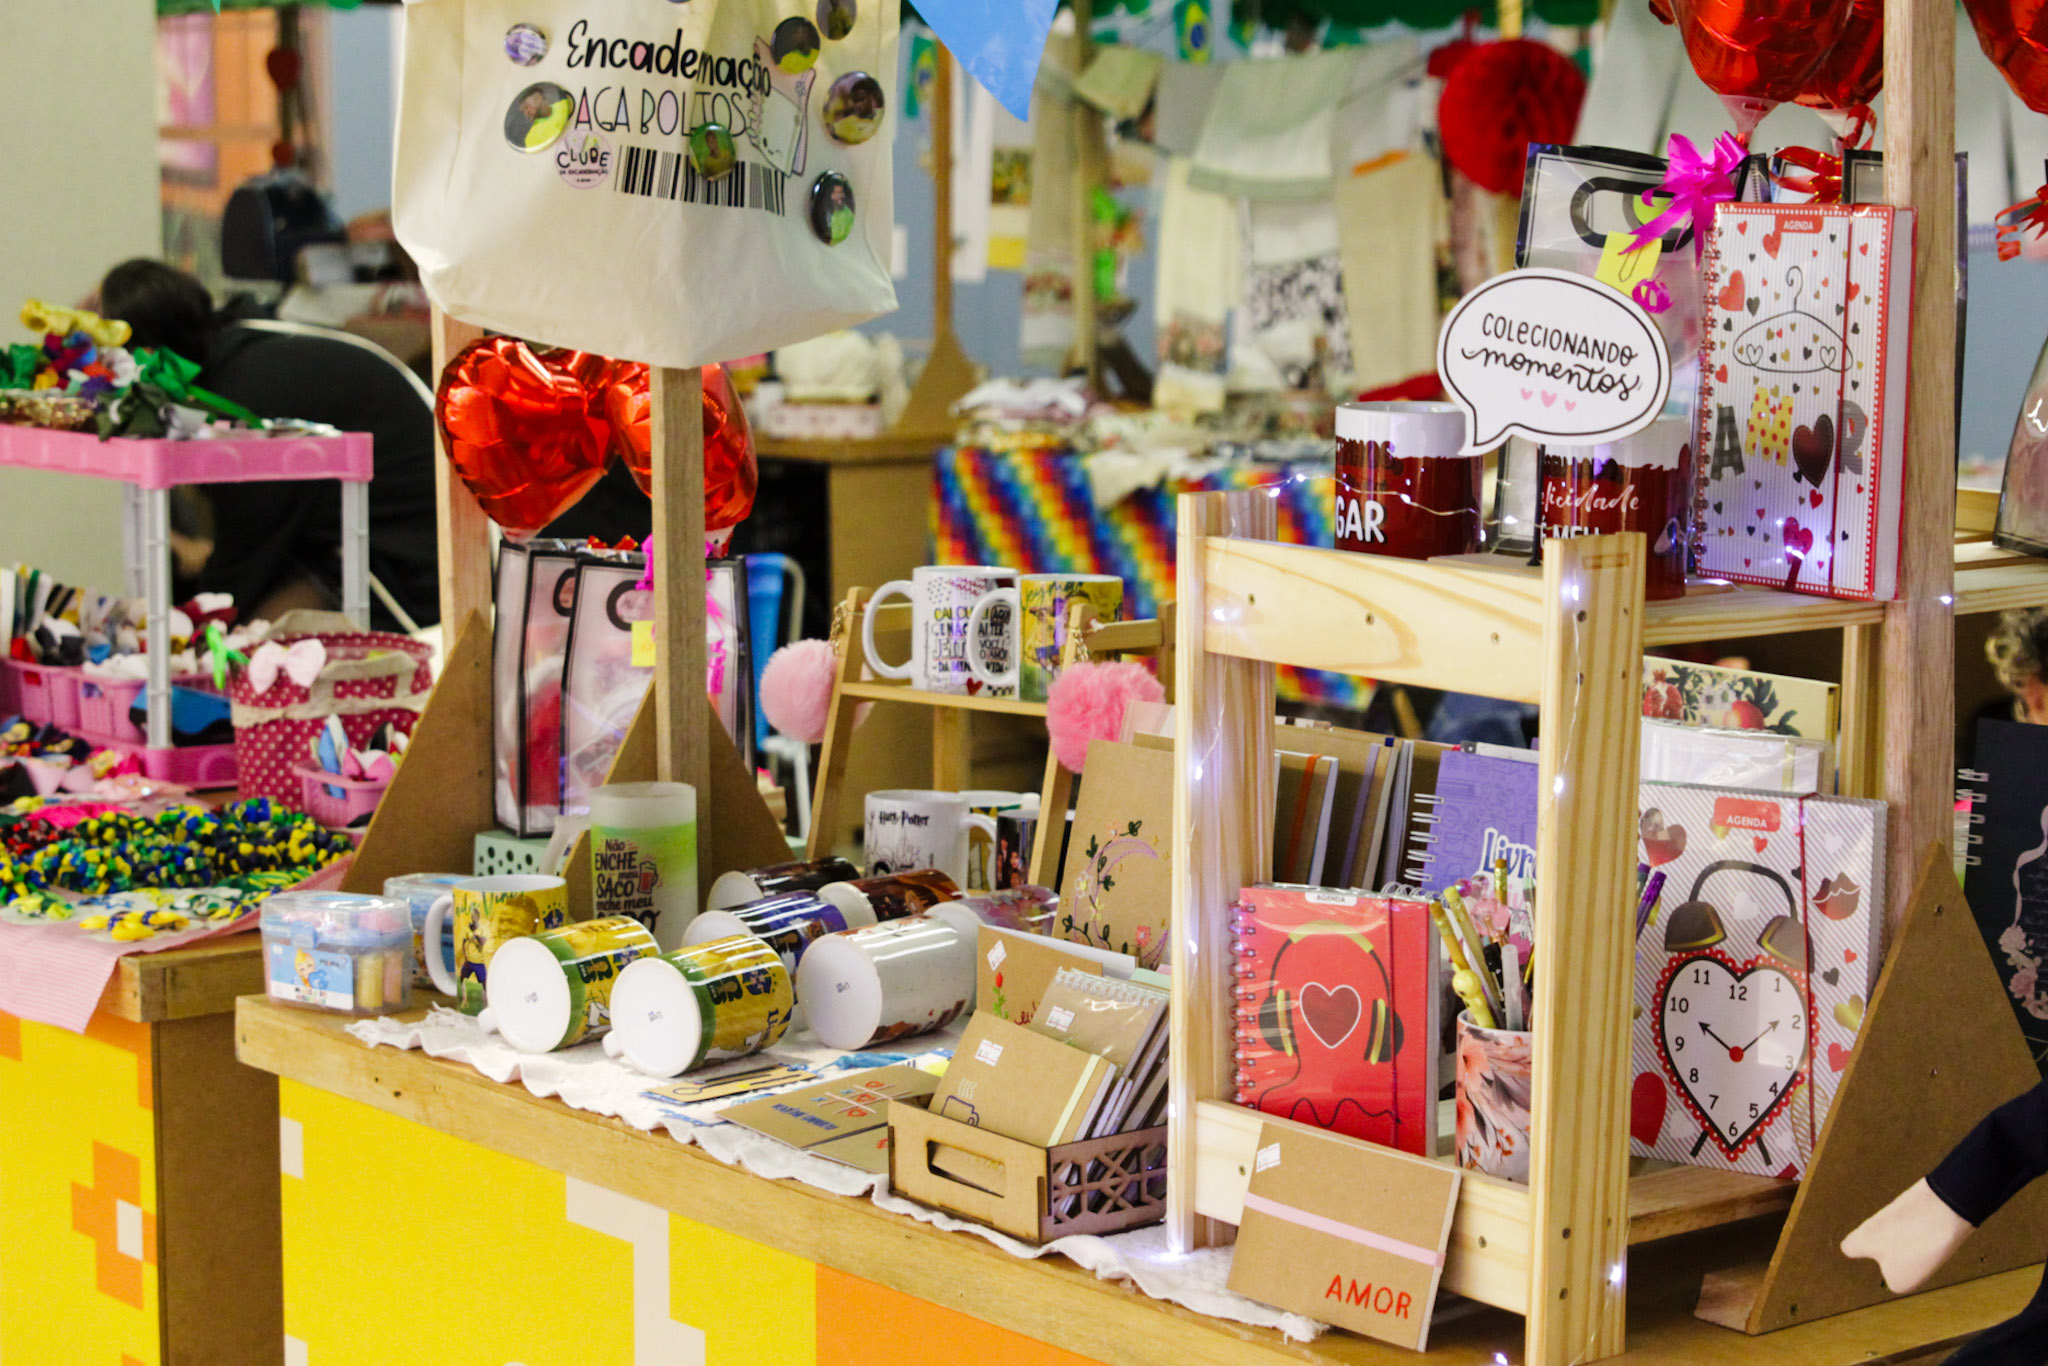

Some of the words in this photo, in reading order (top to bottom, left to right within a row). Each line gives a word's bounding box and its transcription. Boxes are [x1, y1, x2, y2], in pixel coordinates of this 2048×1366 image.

[640, 89, 747, 137] BOLTOS
[557, 147, 611, 168] CLUBE
[1783, 220, 1814, 230] AGENDA
[1482, 312, 1638, 367] COLECIONANDO
[1461, 347, 1642, 401] momentos
[1541, 481, 1640, 513] licidade
[1726, 815, 1768, 828] AGENDA
[605, 838, 625, 852] Não
[595, 851, 638, 871] ENCHE
[1483, 831, 1538, 880] Livr
[596, 873, 635, 899] SACO
[1693, 968, 1711, 986] 11
[1774, 977, 1782, 993] 1
[1729, 985, 1748, 1001] 12
[1670, 997, 1689, 1014] 10
[1791, 1014, 1801, 1030] 2
[1675, 1036, 1685, 1052] 9
[1785, 1055, 1794, 1071] 3
[1689, 1068, 1699, 1083] 8
[1769, 1081, 1778, 1097] 4
[1709, 1094, 1719, 1110] 7
[1749, 1103, 1759, 1119] 5
[1728, 1121, 1738, 1137] 6
[1325, 1274, 1412, 1320] AMOR
